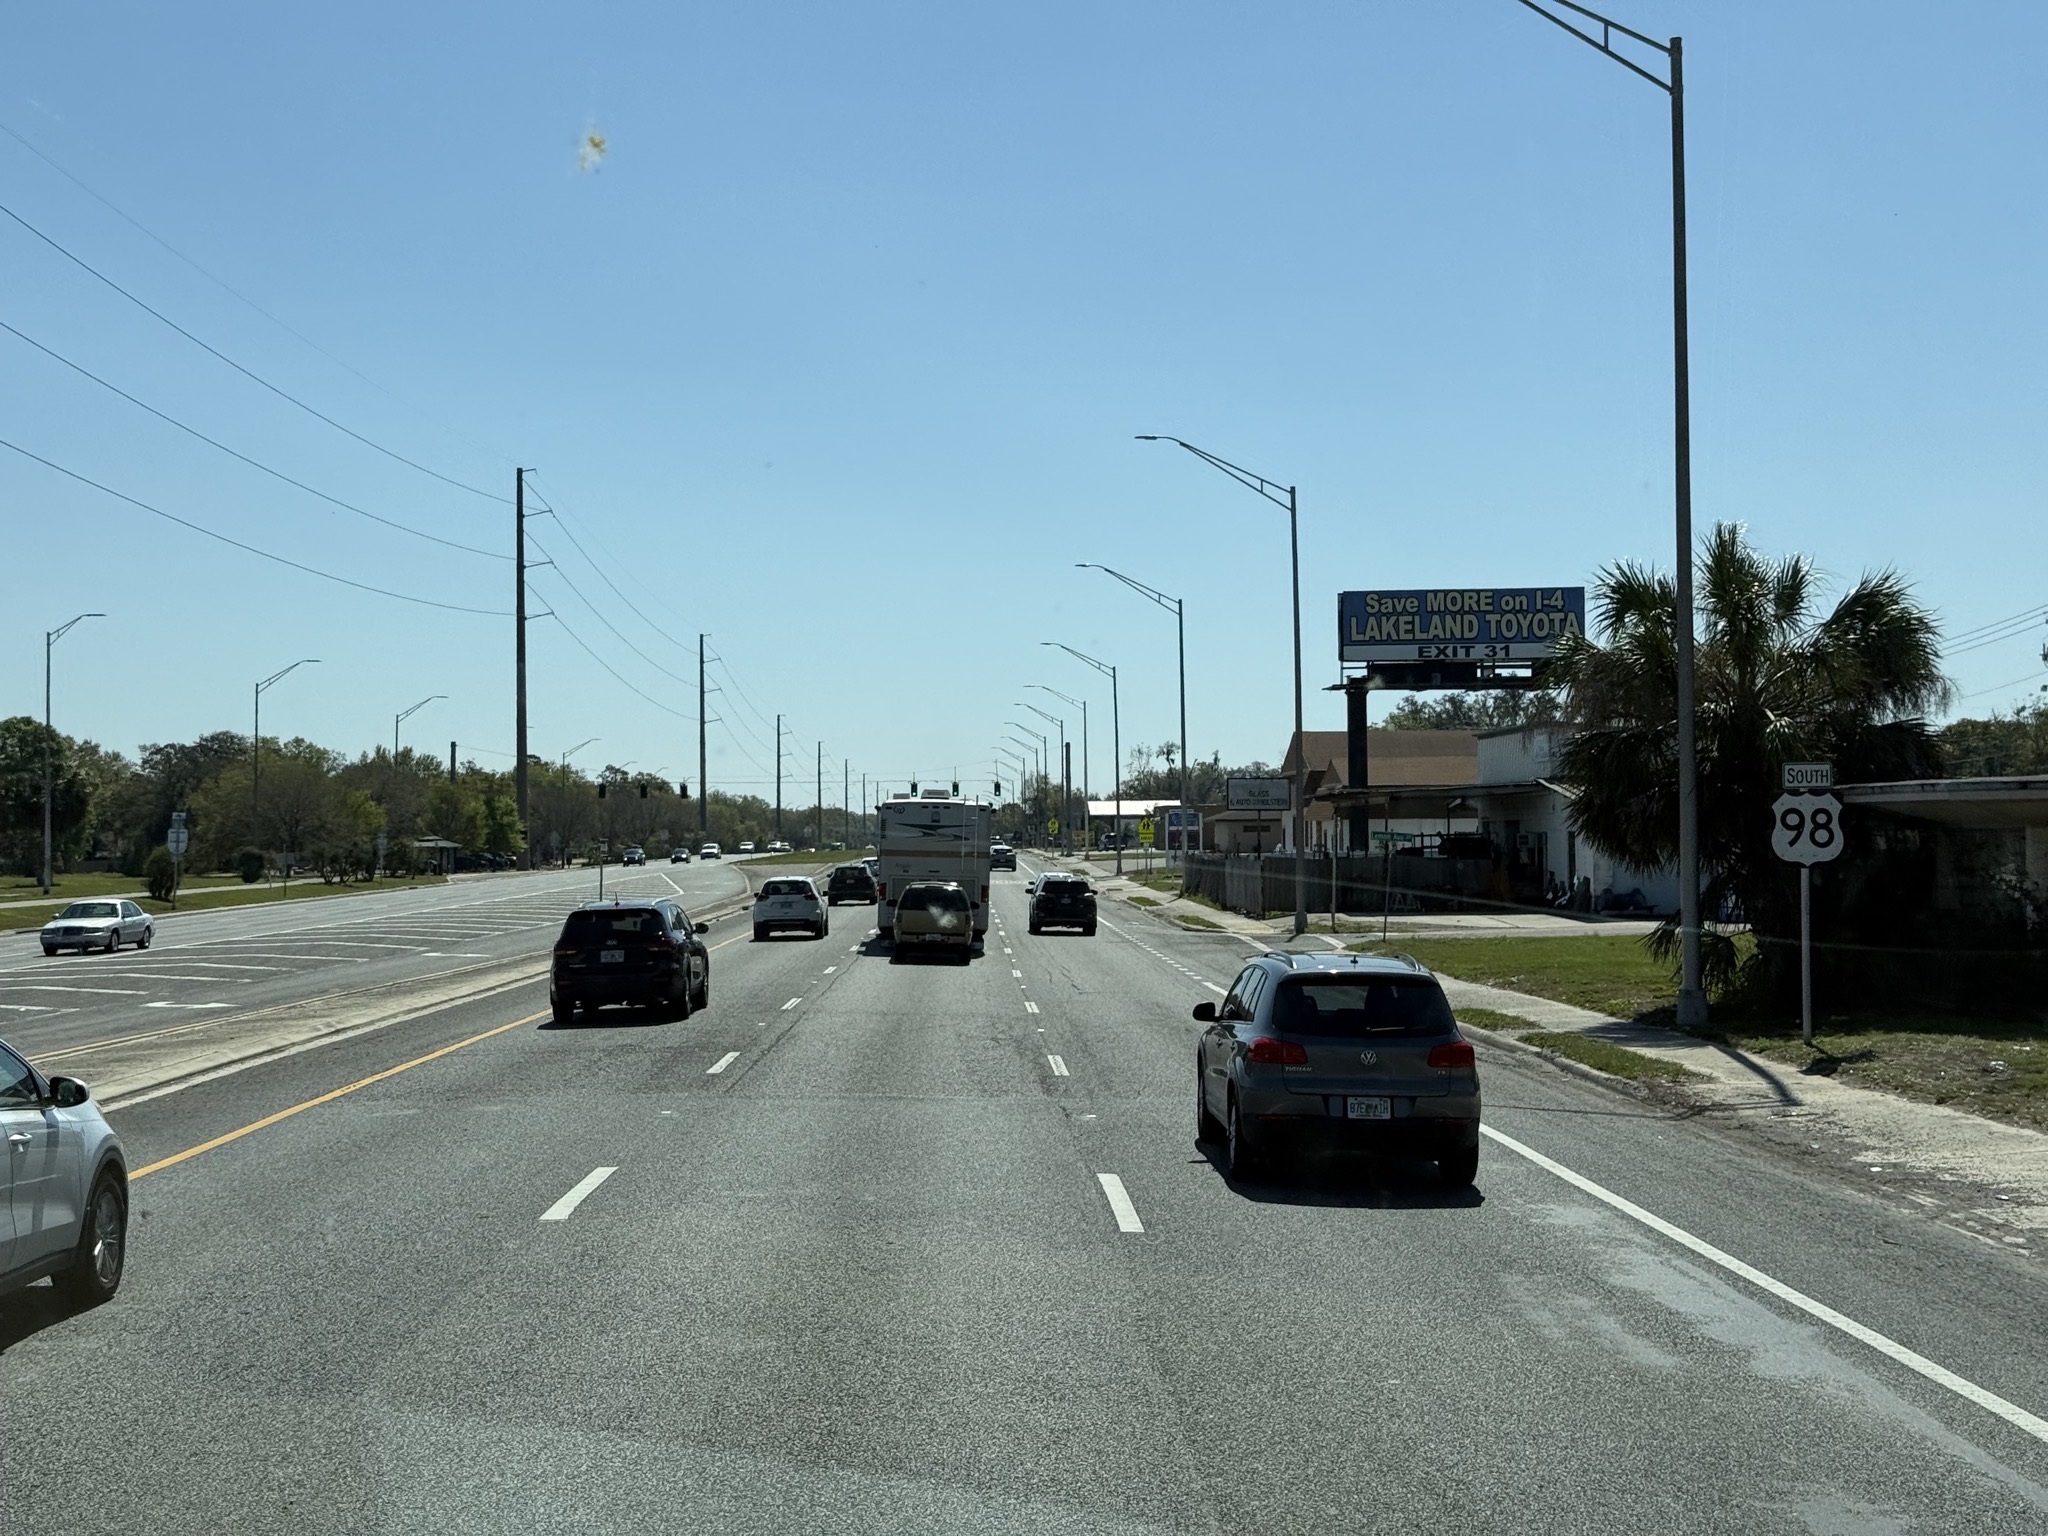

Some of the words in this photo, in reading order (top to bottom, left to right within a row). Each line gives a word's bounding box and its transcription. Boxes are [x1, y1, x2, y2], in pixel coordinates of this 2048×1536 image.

[1365, 592, 1420, 614] Save
[1427, 591, 1494, 612] MORE
[1500, 594, 1527, 612] on
[1535, 589, 1564, 610] I-4
[1350, 613, 1480, 642] LAKELAND
[1485, 611, 1581, 640] TOYOTA
[1417, 644, 1472, 659] EXIT
[1484, 644, 1511, 658] 31
[1787, 768, 1829, 784] SOUTH
[1780, 807, 1834, 848] 98
